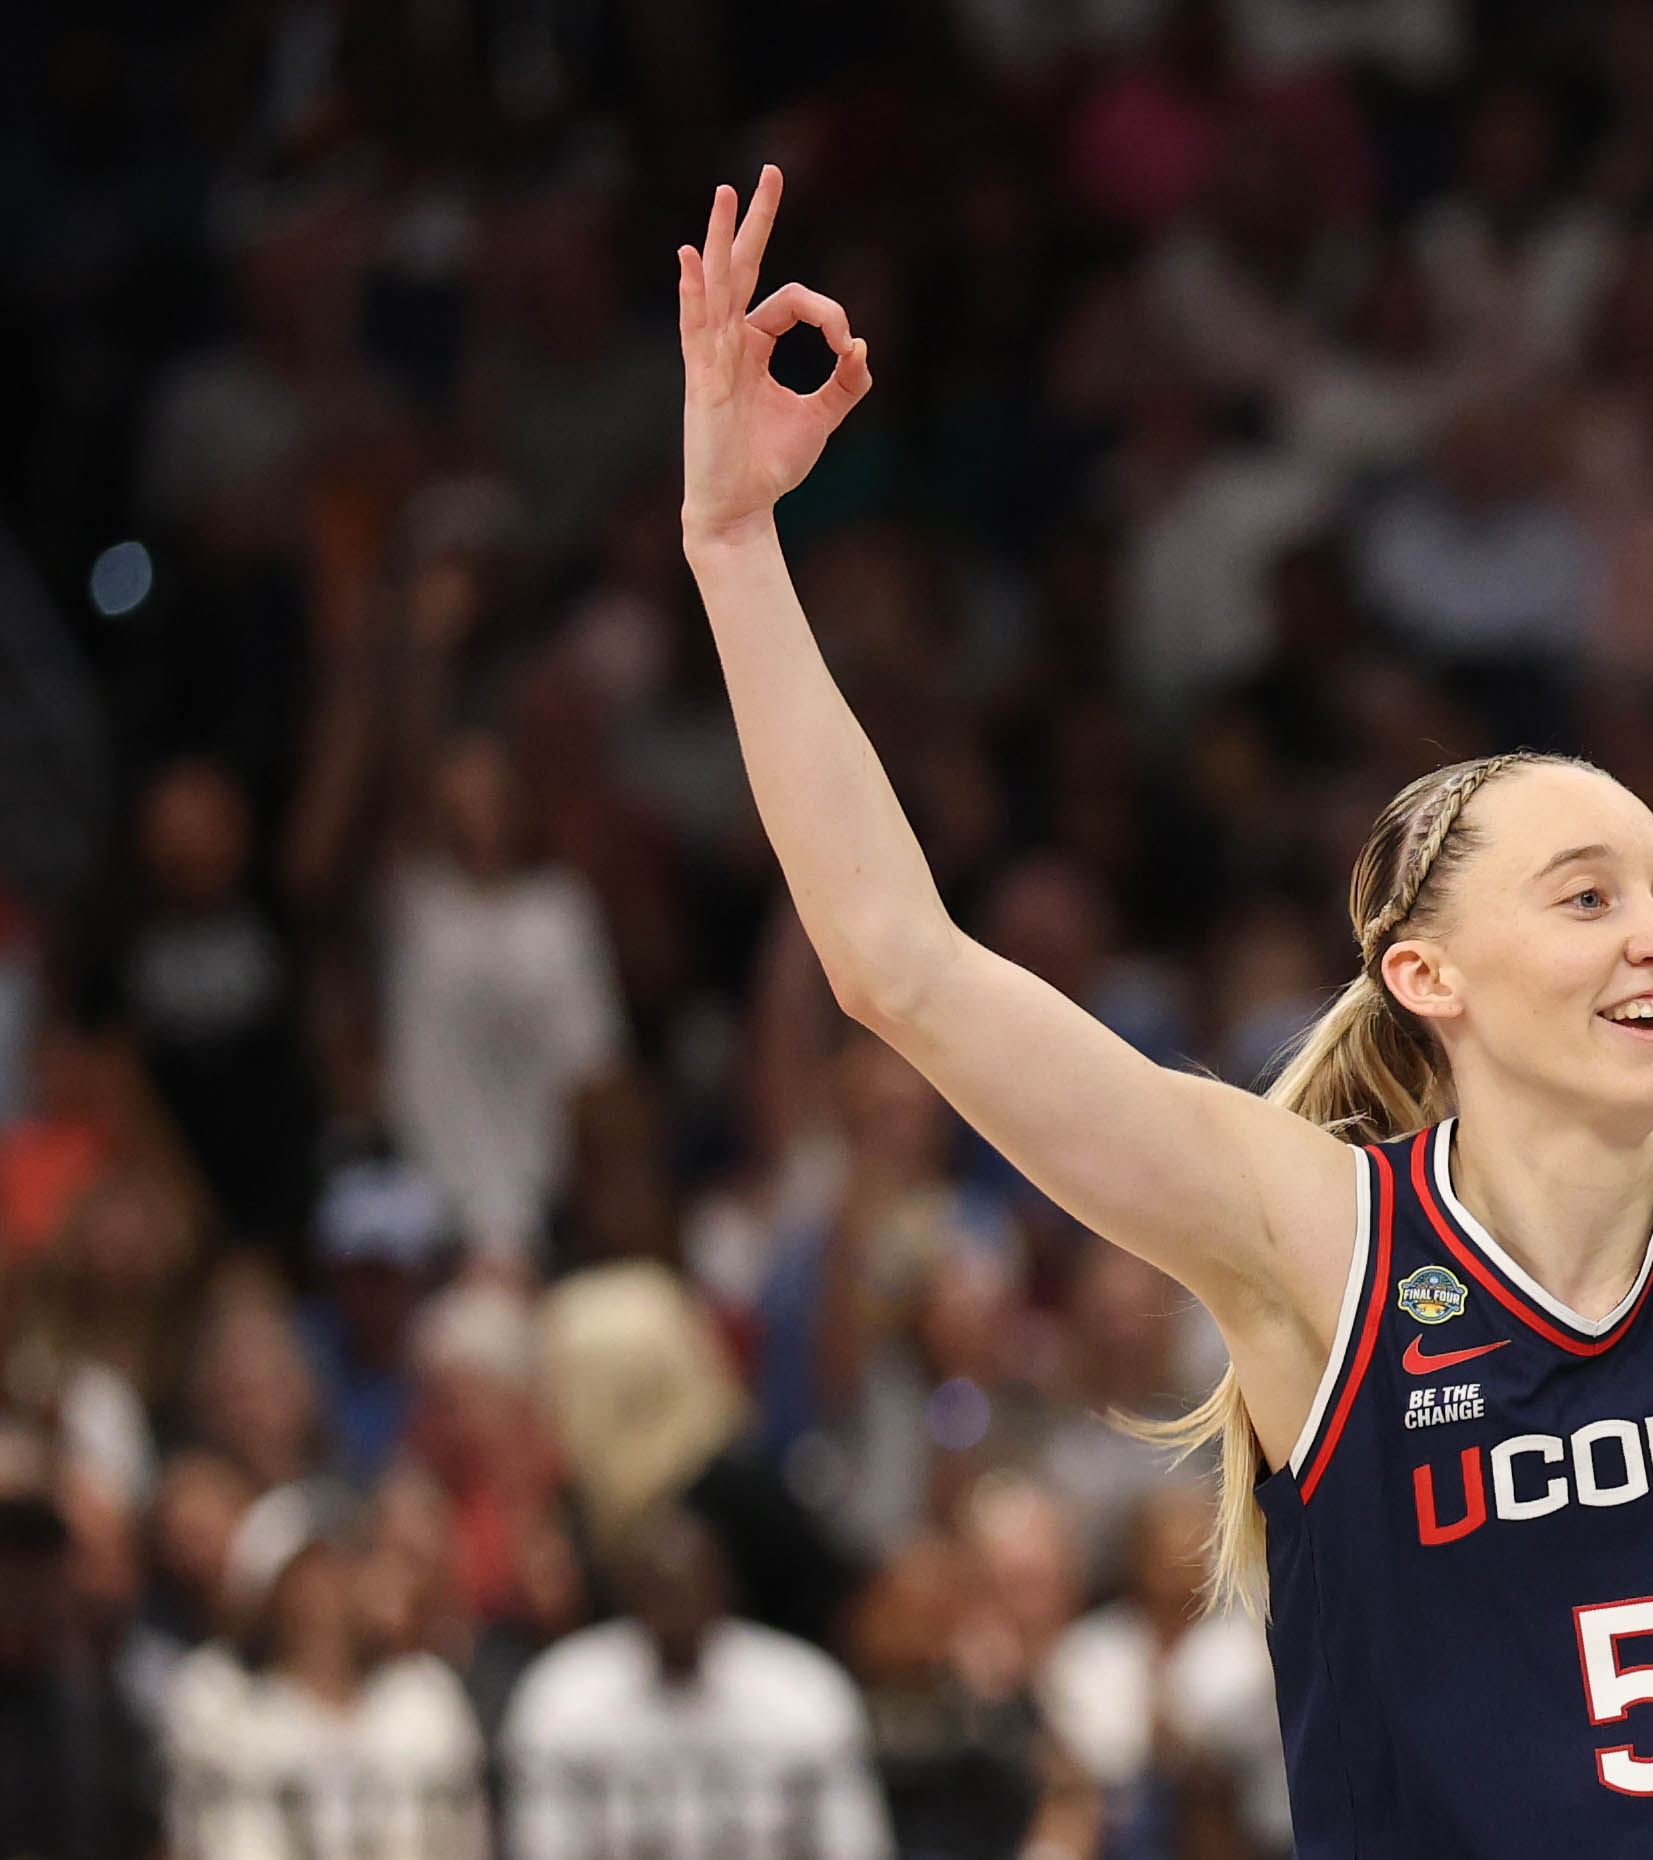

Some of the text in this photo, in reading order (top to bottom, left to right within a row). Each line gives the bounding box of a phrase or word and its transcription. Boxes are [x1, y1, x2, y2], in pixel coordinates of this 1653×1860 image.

[1404, 1288, 1460, 1305] FINAL FOUR
[1409, 1383, 1481, 1409] BE THE
[1404, 1398, 1485, 1430] CHANGE
